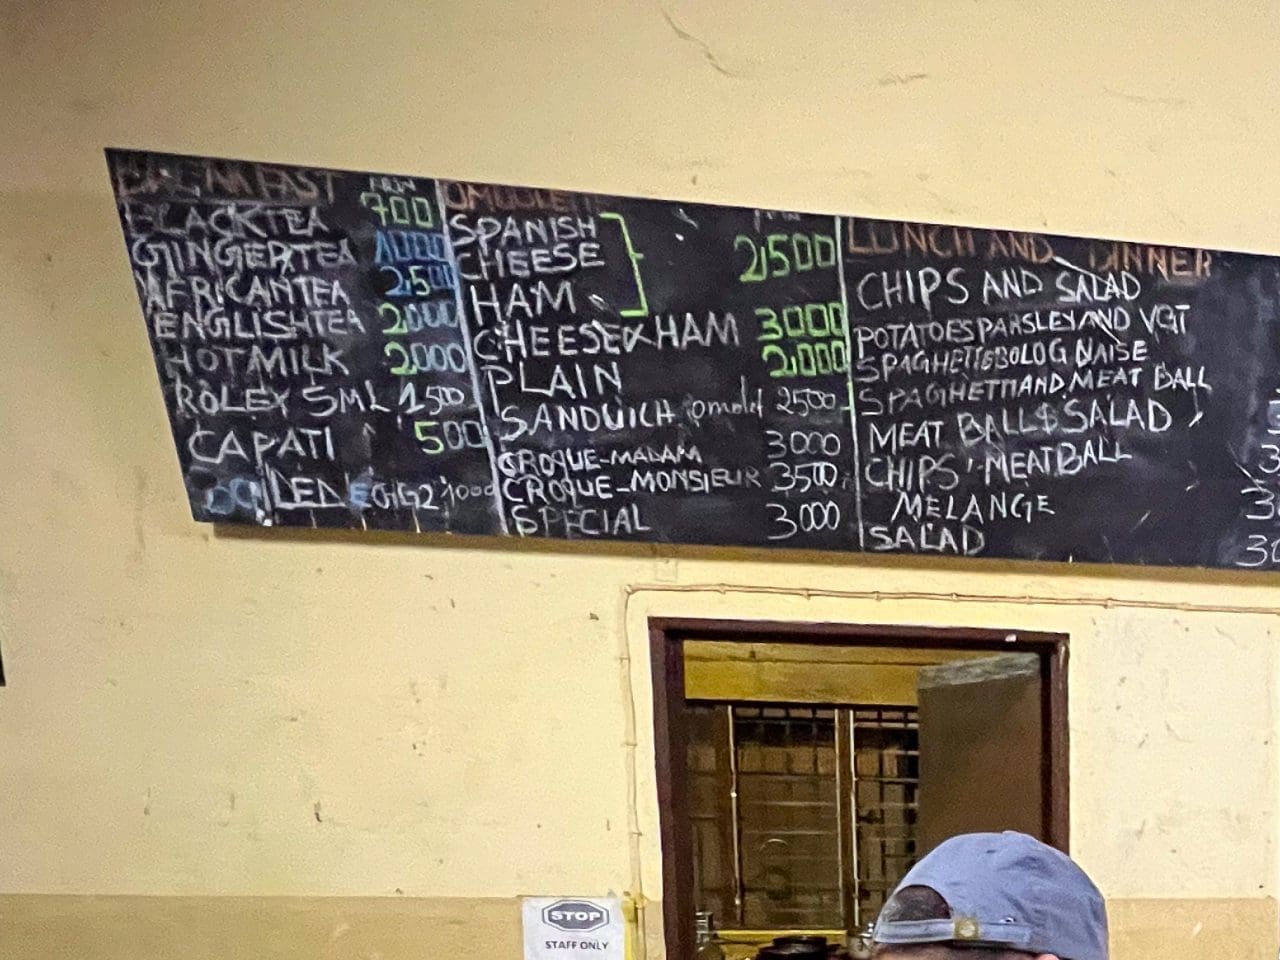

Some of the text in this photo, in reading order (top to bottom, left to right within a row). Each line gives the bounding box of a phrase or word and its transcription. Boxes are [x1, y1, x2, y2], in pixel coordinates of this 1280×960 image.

[361, 192, 433, 228] 700
[449, 213, 597, 254] SPANISH
[456, 242, 605, 280] CHEESE
[469, 280, 576, 327] HAM
[857, 267, 969, 312] CHIPS
[982, 269, 1043, 306] AND
[1055, 270, 1142, 304] SALAD
[377, 302, 458, 335] 2000
[755, 302, 845, 341] 3000
[384, 341, 465, 376] 2000
[481, 343, 848, 415] PLAIN 2000
[1153, 361, 1213, 392] BALL
[777, 386, 836, 417] 2500
[414, 419, 487, 454] 500
[766, 429, 841, 459] 3000
[869, 420, 945, 455] MEAT
[769, 461, 838, 493] 3500
[865, 453, 960, 493] CHIPS
[510, 500, 841, 540] SPECIAL 3000
[891, 491, 1056, 524] MELANGE
[869, 525, 985, 556] SALAD
[551, 911, 601, 922] STOP
[545, 941, 609, 951] STAFF ONLY
